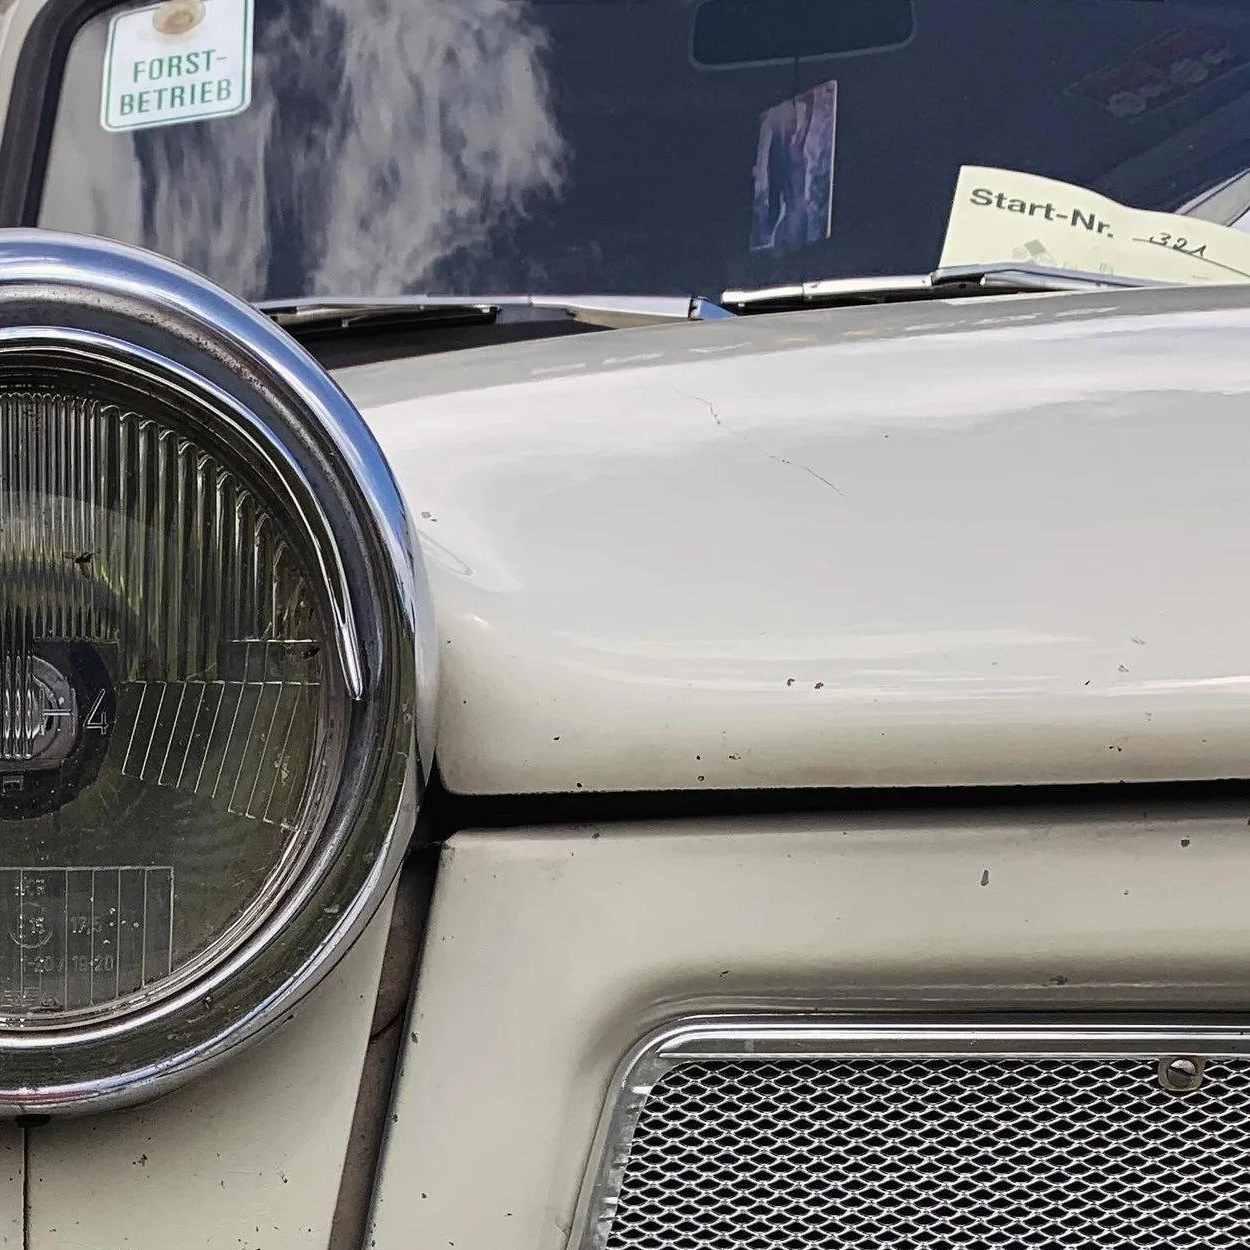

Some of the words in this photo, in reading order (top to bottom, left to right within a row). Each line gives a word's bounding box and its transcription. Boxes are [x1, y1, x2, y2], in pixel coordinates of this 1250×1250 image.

[132, 49, 228, 83] FORST-
[120, 78, 232, 116] BETRIEB
[969, 187, 1115, 239] Start-Nr.
